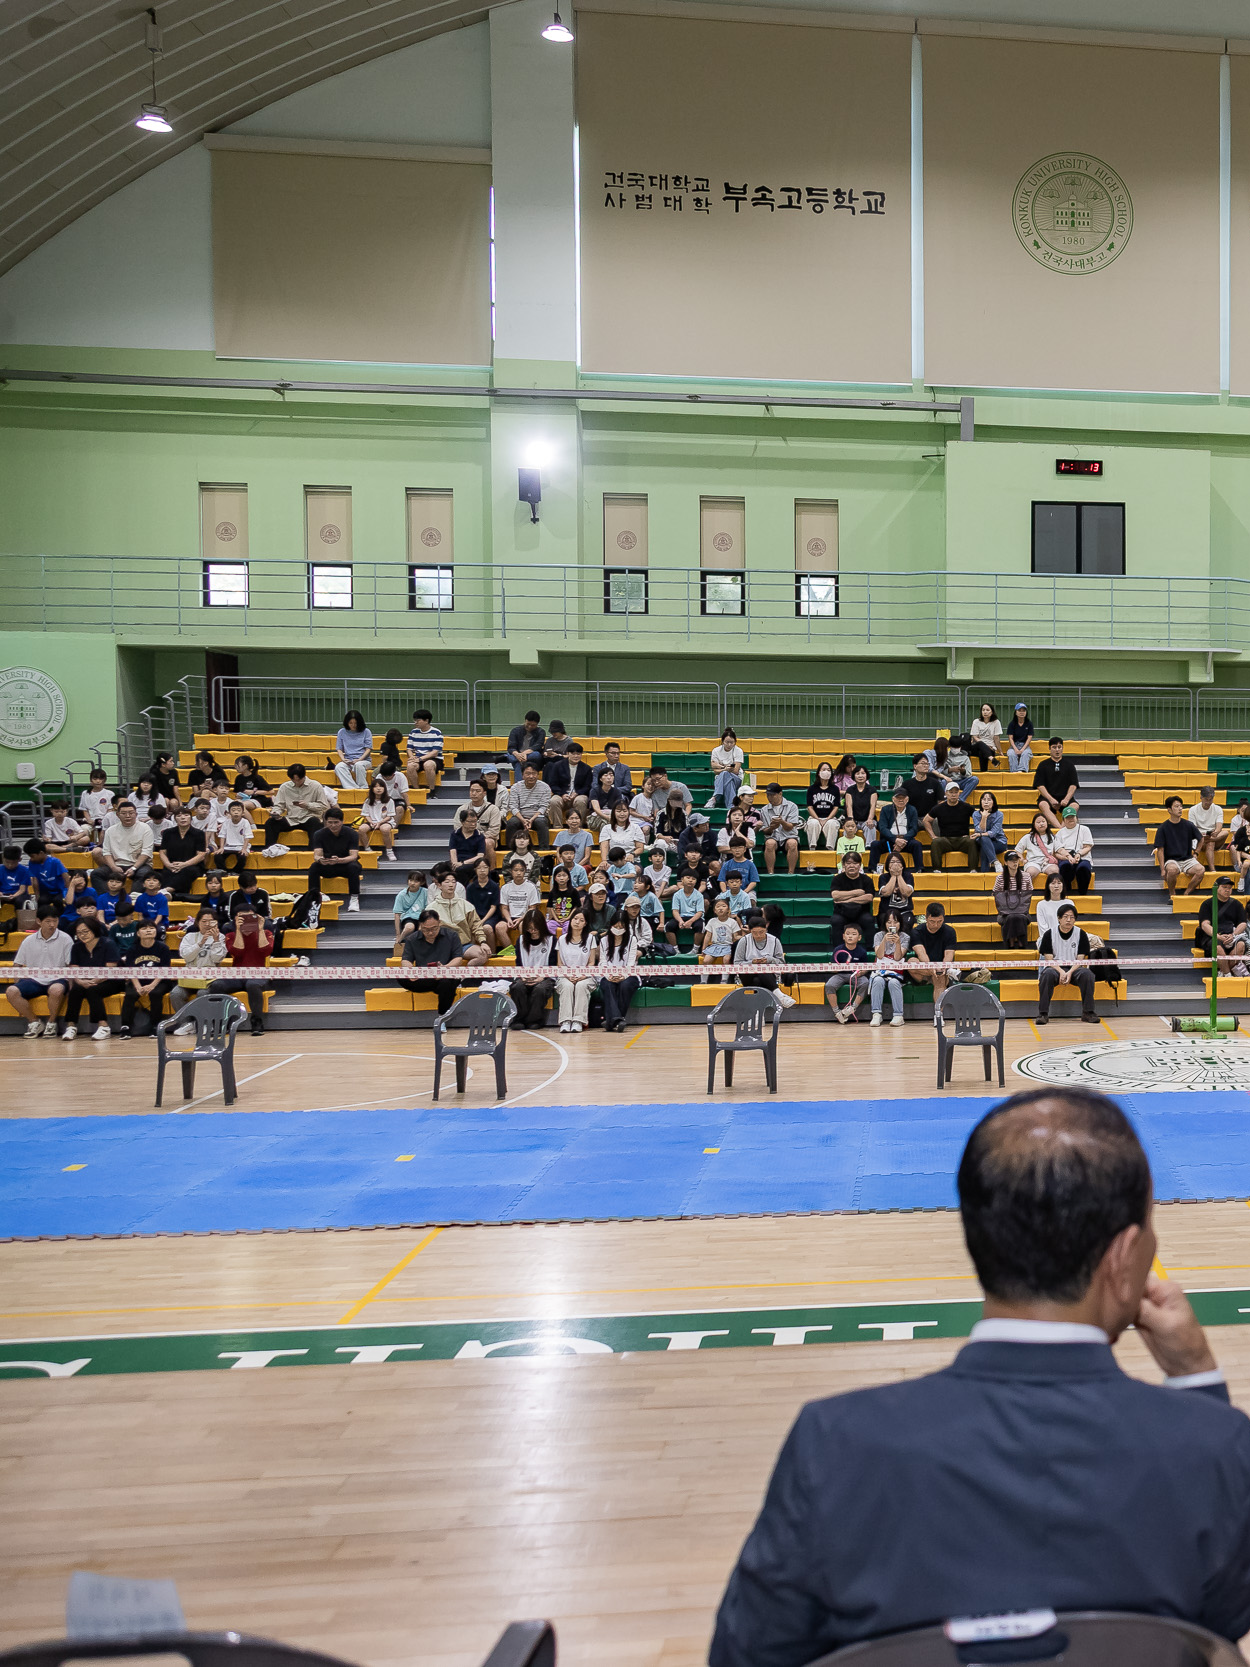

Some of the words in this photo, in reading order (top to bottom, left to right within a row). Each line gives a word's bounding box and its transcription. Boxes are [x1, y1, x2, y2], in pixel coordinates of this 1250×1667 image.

[604, 172, 710, 193] 건국대학교
[722, 181, 886, 216] 부속고등학교
[1018, 188, 1034, 238] KONKUK
[1028, 158, 1092, 187] UNIVERSITY
[1094, 167, 1120, 193] HIGH
[1114, 195, 1128, 238] SCHOOL
[1062, 236, 1085, 245] 1980
[38, 676, 56, 693] HIGH
[53, 694, 63, 724] SCHOOL
